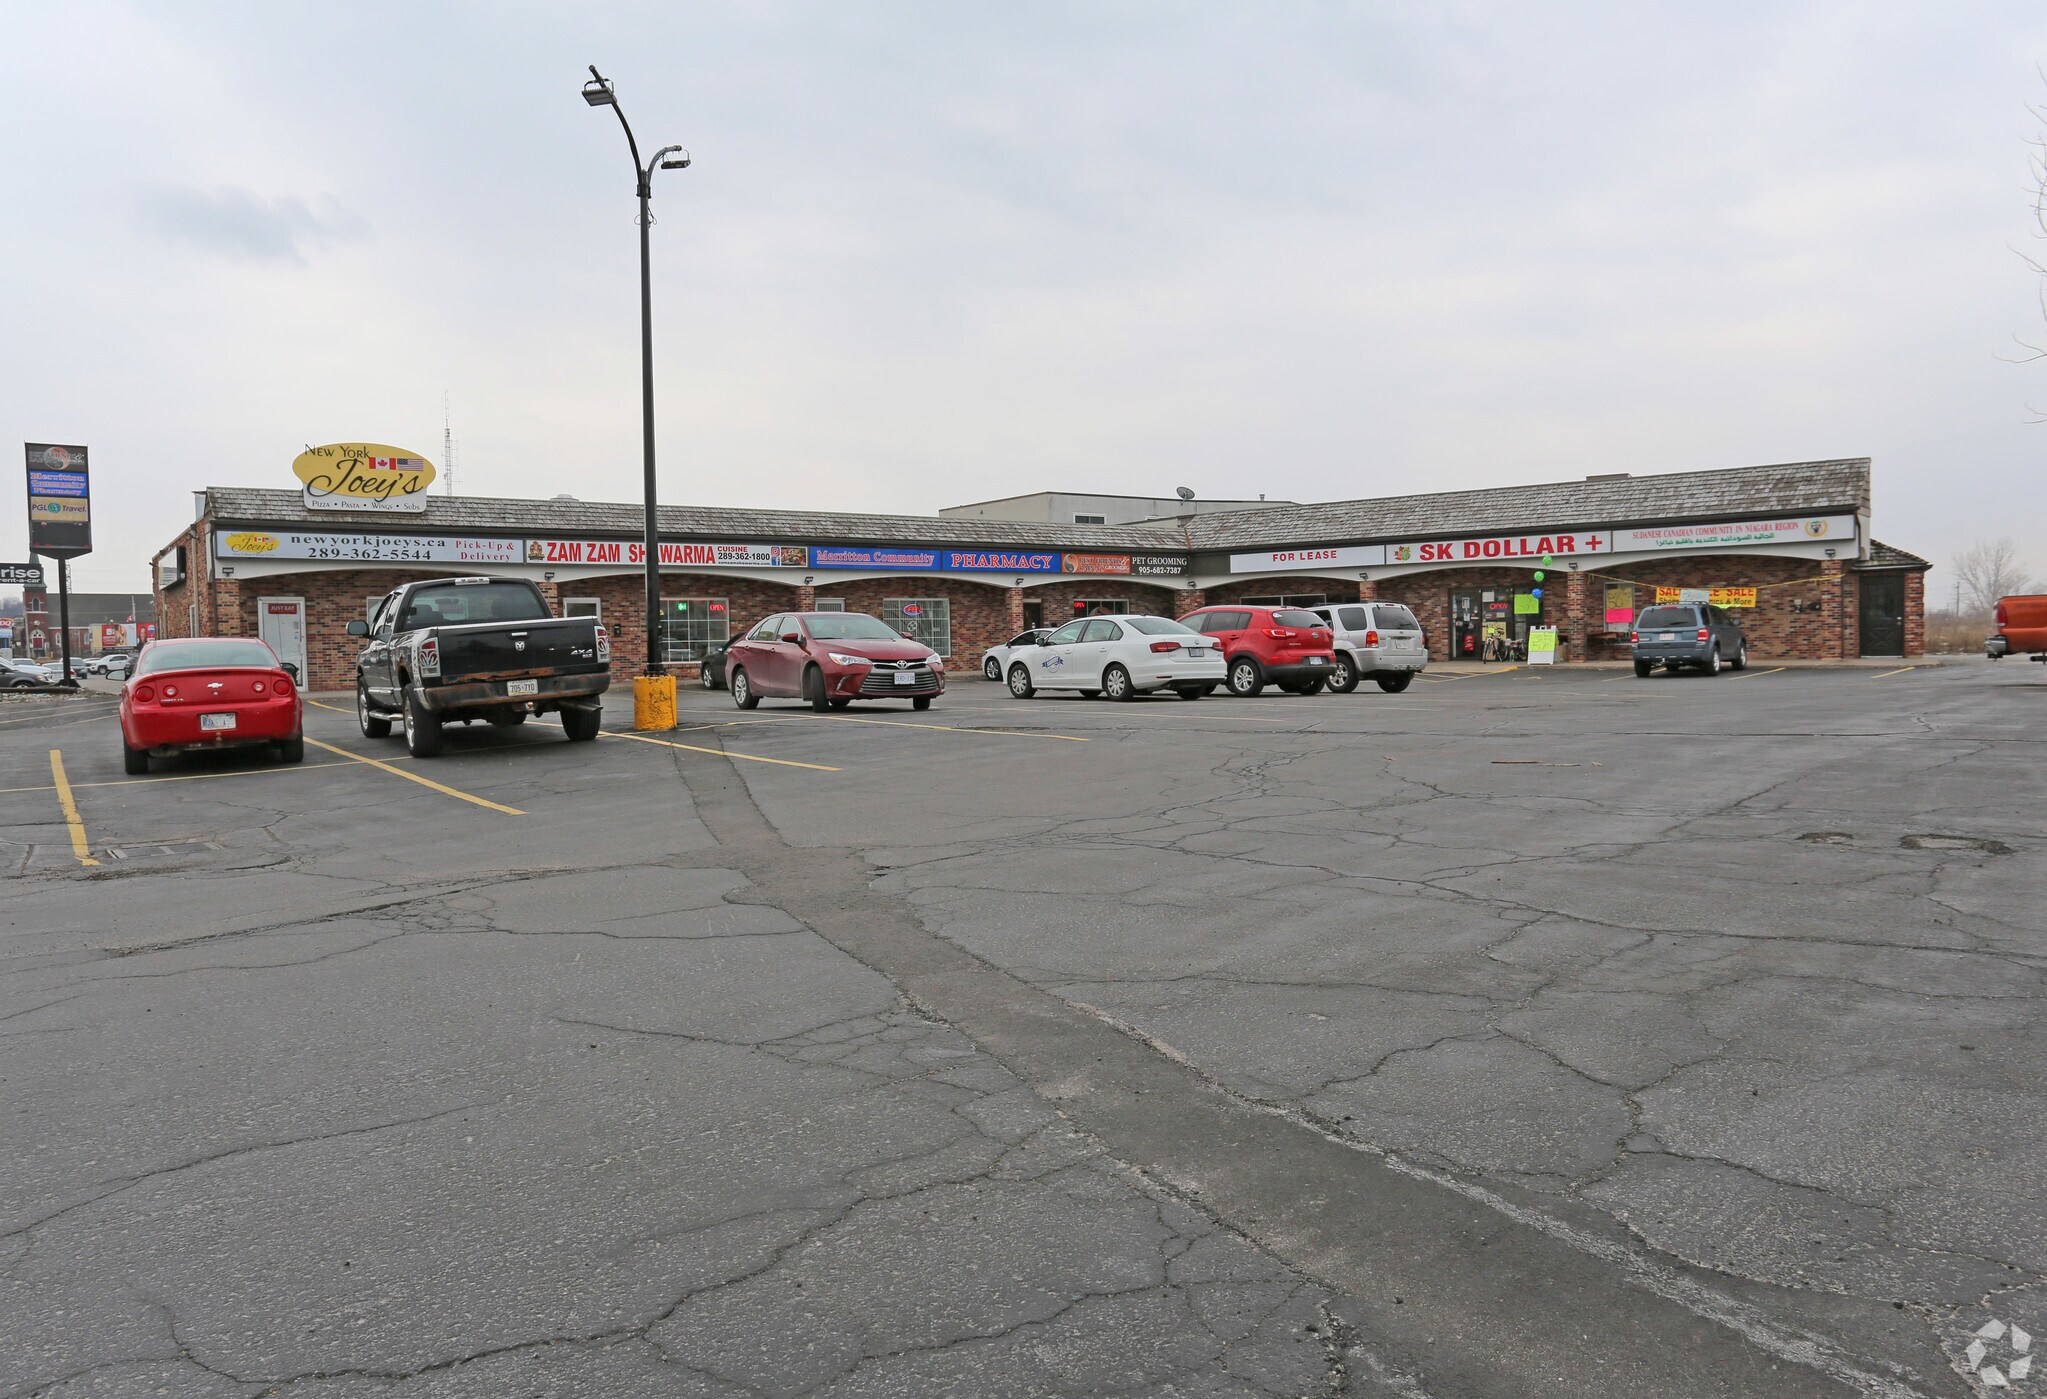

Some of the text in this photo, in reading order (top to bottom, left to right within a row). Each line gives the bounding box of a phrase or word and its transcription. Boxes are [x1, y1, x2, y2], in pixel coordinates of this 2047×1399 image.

[306, 458, 424, 502] Joey's
[31, 504, 48, 512] PGL
[1632, 522, 1799, 539] SUDANESE CANADIAN COMMUNITY IN NIAGARA REGION
[291, 536, 446, 548] newyorkjoeys.ca
[455, 540, 503, 550] Pick-Up
[1419, 543, 1454, 561] SK
[1463, 535, 1575, 558] DOLLAR
[308, 547, 432, 560] 289-362-5544
[460, 552, 511, 562] Delivery
[546, 542, 716, 564] ZAM ZAM SHWARMA
[718, 552, 770, 561] 289-362-1800
[816, 550, 935, 565] Merritton Community
[1272, 550, 1337, 562] FOR LEASE
[951, 554, 1052, 568] PHARMACY
[1132, 557, 1187, 566] PET GROOMING
[1, 566, 41, 578] rise
[1138, 566, 1182, 574] 905-682-7387
[1727, 588, 1755, 597] SALE
